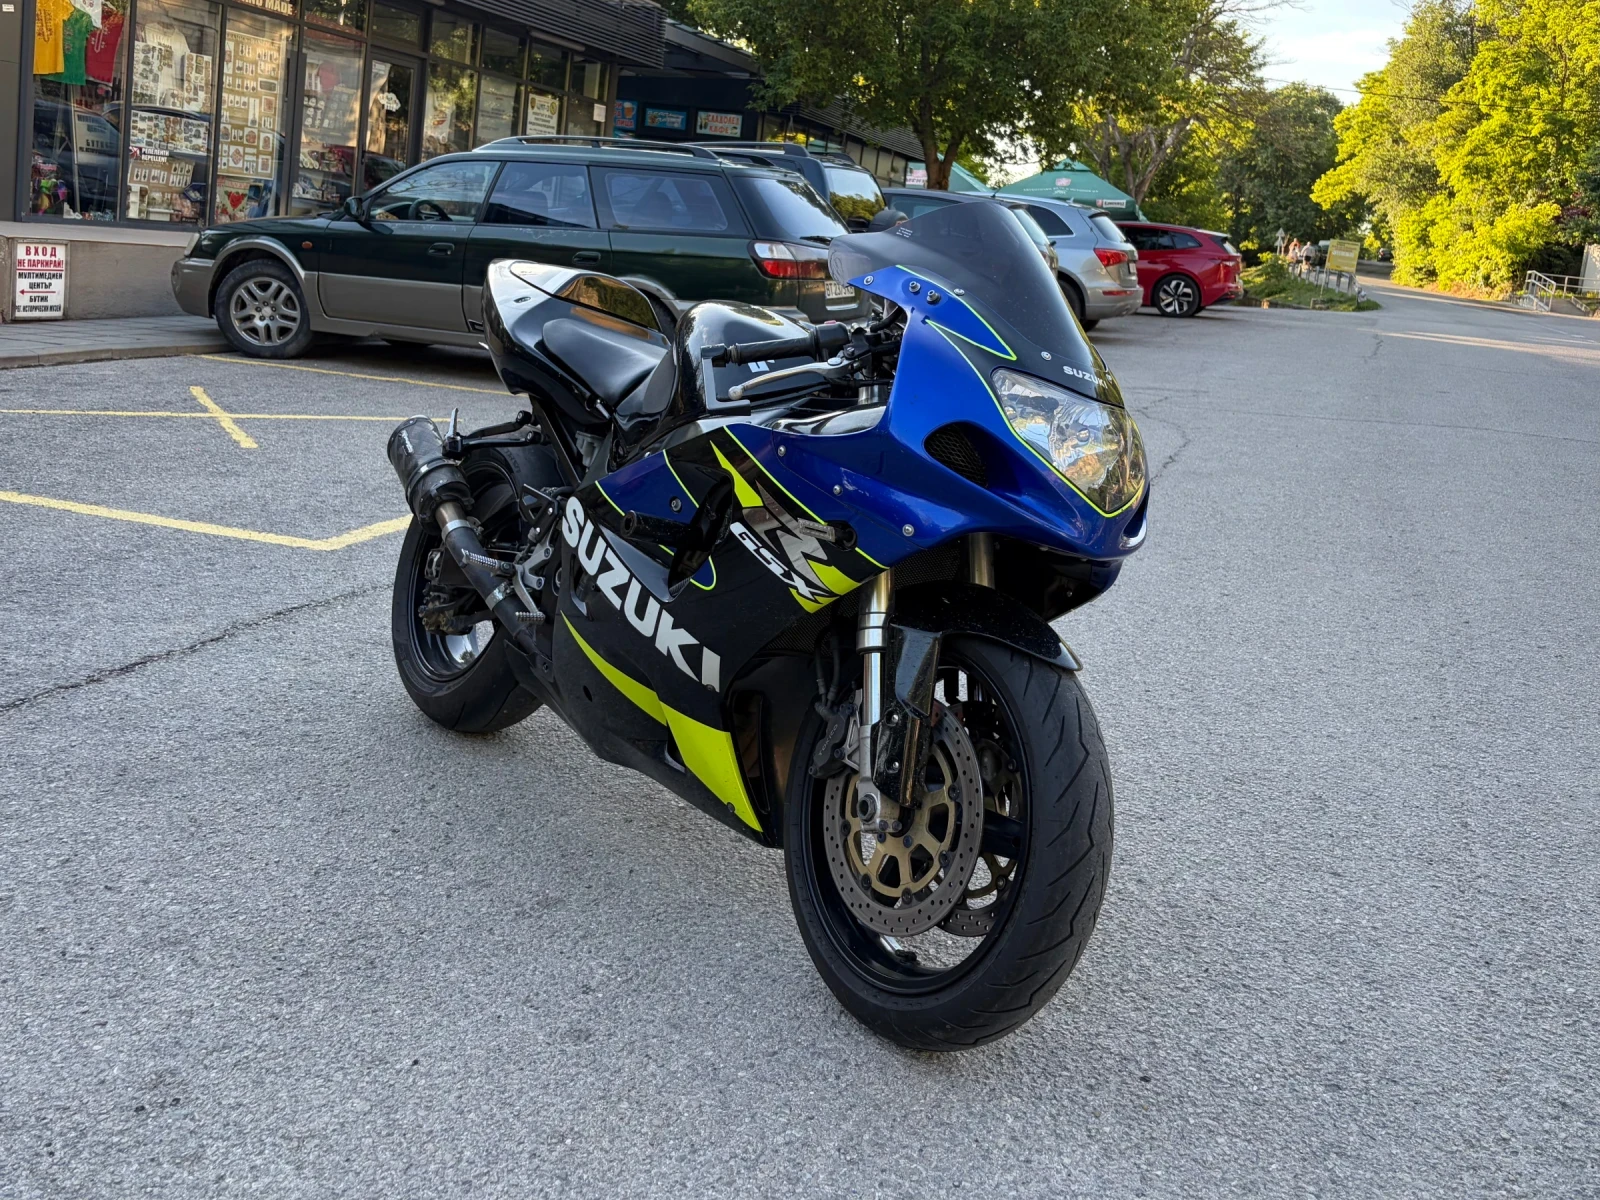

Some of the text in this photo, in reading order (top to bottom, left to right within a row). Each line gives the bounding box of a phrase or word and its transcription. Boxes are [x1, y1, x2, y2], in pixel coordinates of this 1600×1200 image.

[265, 0, 293, 15] MADE
[25, 246, 57, 258] ВХОД
[17, 258, 64, 268] НЕ ПАРКИРАЙ!
[18, 272, 63, 280] МУЛТИМЕДИЕН
[29, 282, 53, 290] ЦЕНТЪР
[29, 295, 49, 303] БУТИК
[729, 521, 832, 601] GSX
[562, 496, 721, 693] SUZUKI
[818, 723, 838, 756] TOKICO
